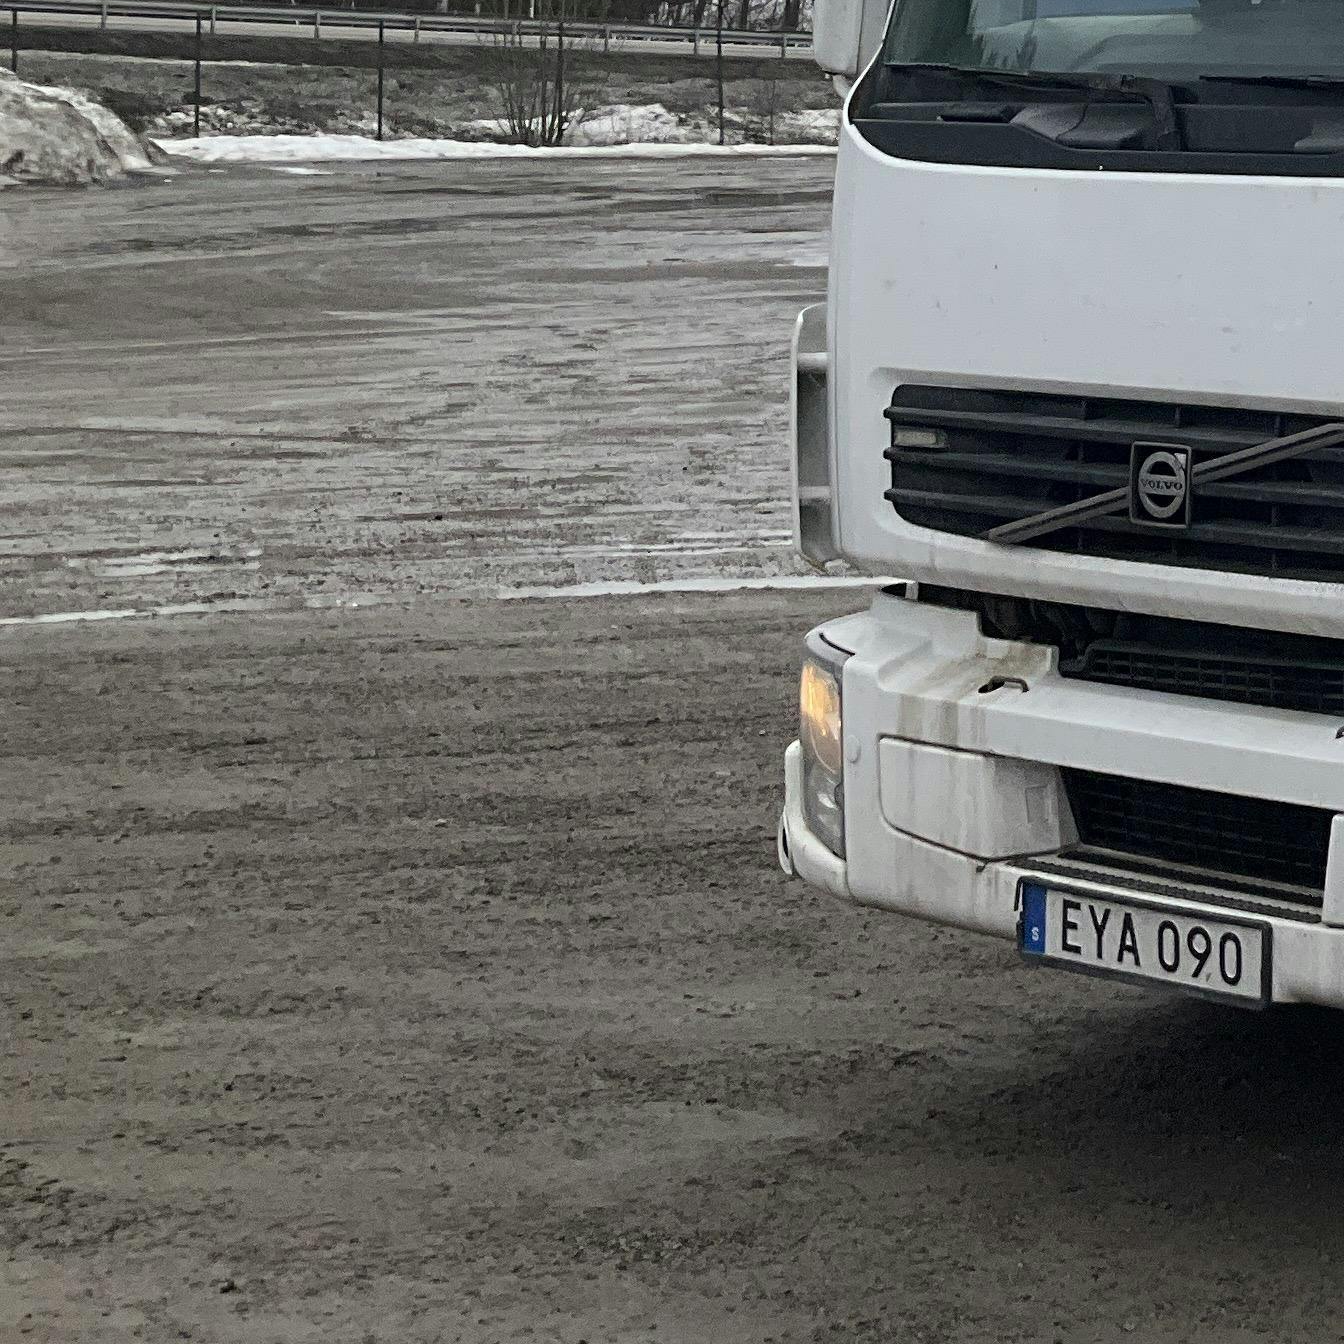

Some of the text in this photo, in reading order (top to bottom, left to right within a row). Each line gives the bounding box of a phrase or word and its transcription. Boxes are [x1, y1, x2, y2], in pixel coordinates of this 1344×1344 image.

[1140, 478, 1183, 491] VOLVO
[1031, 926, 1040, 942] S
[1061, 898, 1243, 987] EYA 090
